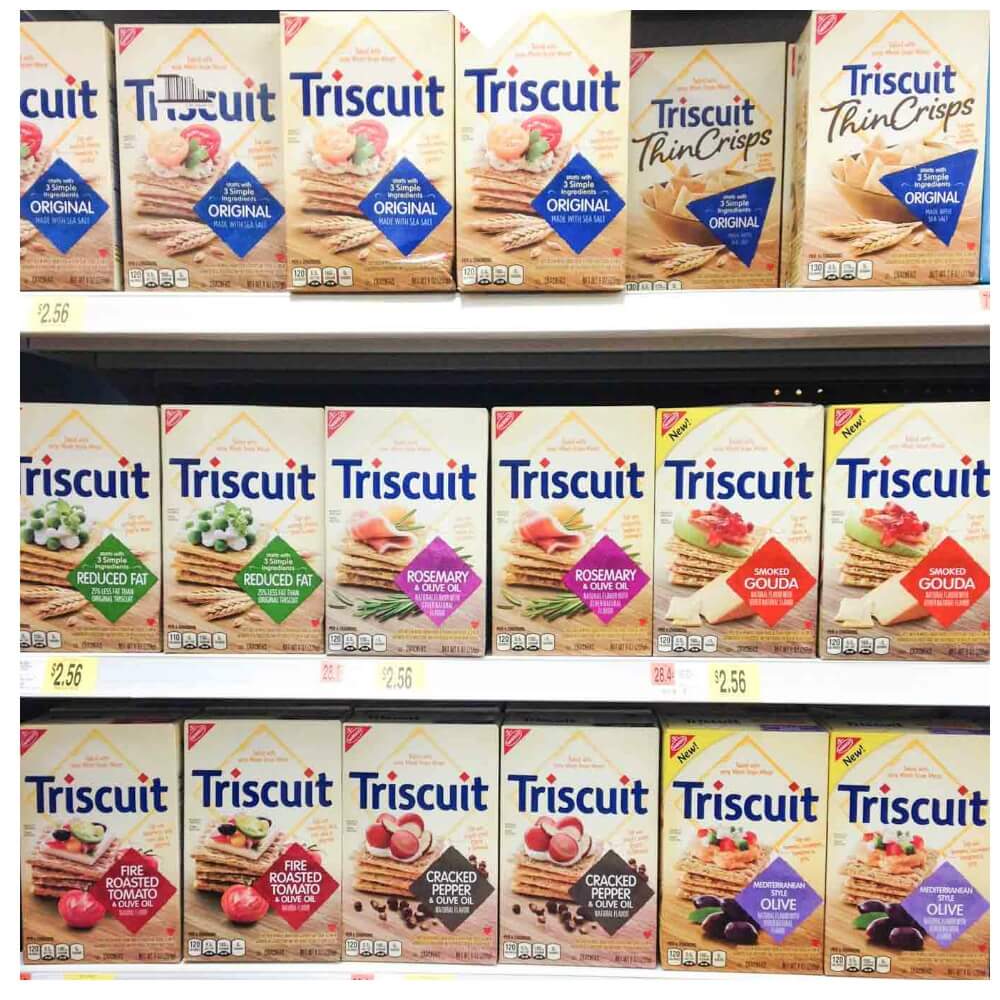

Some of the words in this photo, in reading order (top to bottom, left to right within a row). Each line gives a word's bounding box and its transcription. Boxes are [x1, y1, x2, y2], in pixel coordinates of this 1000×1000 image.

[843, 60, 956, 96] Triscuit
[290, 72, 445, 117] Triscuit
[464, 69, 620, 112] Triscuit
[651, 94, 755, 128] Triscuit
[547, 197, 611, 212] ORIGINAL
[905, 192, 960, 204] ORIGINAL
[30, 201, 94, 214] ORIGINAL
[208, 205, 271, 218] ORIGINAL
[373, 201, 437, 215] ORIGINAL
[709, 217, 759, 228] ORIGINAL
[38, 304, 69, 324] $2.56
[670, 419, 692, 441] New!
[842, 415, 865, 438] New!
[169, 458, 316, 500] Triscuit
[332, 459, 477, 500] Triscuit
[499, 458, 645, 499] Triscuit
[664, 458, 814, 499] Triscuit
[836, 456, 990, 499] Triscuit
[77, 573, 127, 585] REDUCED
[131, 573, 149, 585] FAT
[244, 573, 293, 586] REDUCED
[297, 573, 312, 586] FAT
[407, 571, 469, 583] ROSEMARY
[575, 569, 636, 581] ROSEMARY
[744, 577, 798, 589] GOUDA
[919, 577, 975, 589] GOUDA
[51, 663, 83, 686] $2.56
[383, 667, 412, 689] $2.56
[715, 670, 746, 693] $2.56
[678, 742, 699, 763] New!
[843, 745, 865, 767] New!
[25, 774, 168, 813] Triscuit
[192, 768, 333, 808] Triscuit
[349, 771, 489, 811] Triscuit
[508, 774, 648, 814] Triscuit
[672, 780, 819, 822] Triscuit
[838, 784, 988, 826] Triscuit
[121, 865, 144, 876] FIRE
[285, 860, 307, 871] FIRE
[106, 877, 159, 888] ROASTED
[269, 872, 322, 883] ROASTED
[426, 871, 477, 883] CRACKED
[585, 875, 636, 887] CRACKED
[271, 884, 320, 895] TOMATO
[432, 884, 471, 895] PEPPER
[753, 881, 805, 889] MEDITERRANEAN
[920, 886, 973, 894] MEDITERRANEAN
[108, 889, 157, 900] TOMATO
[591, 888, 631, 900] PEPPER
[760, 899, 797, 911] OLIVE
[927, 903, 963, 915] OLIVE
